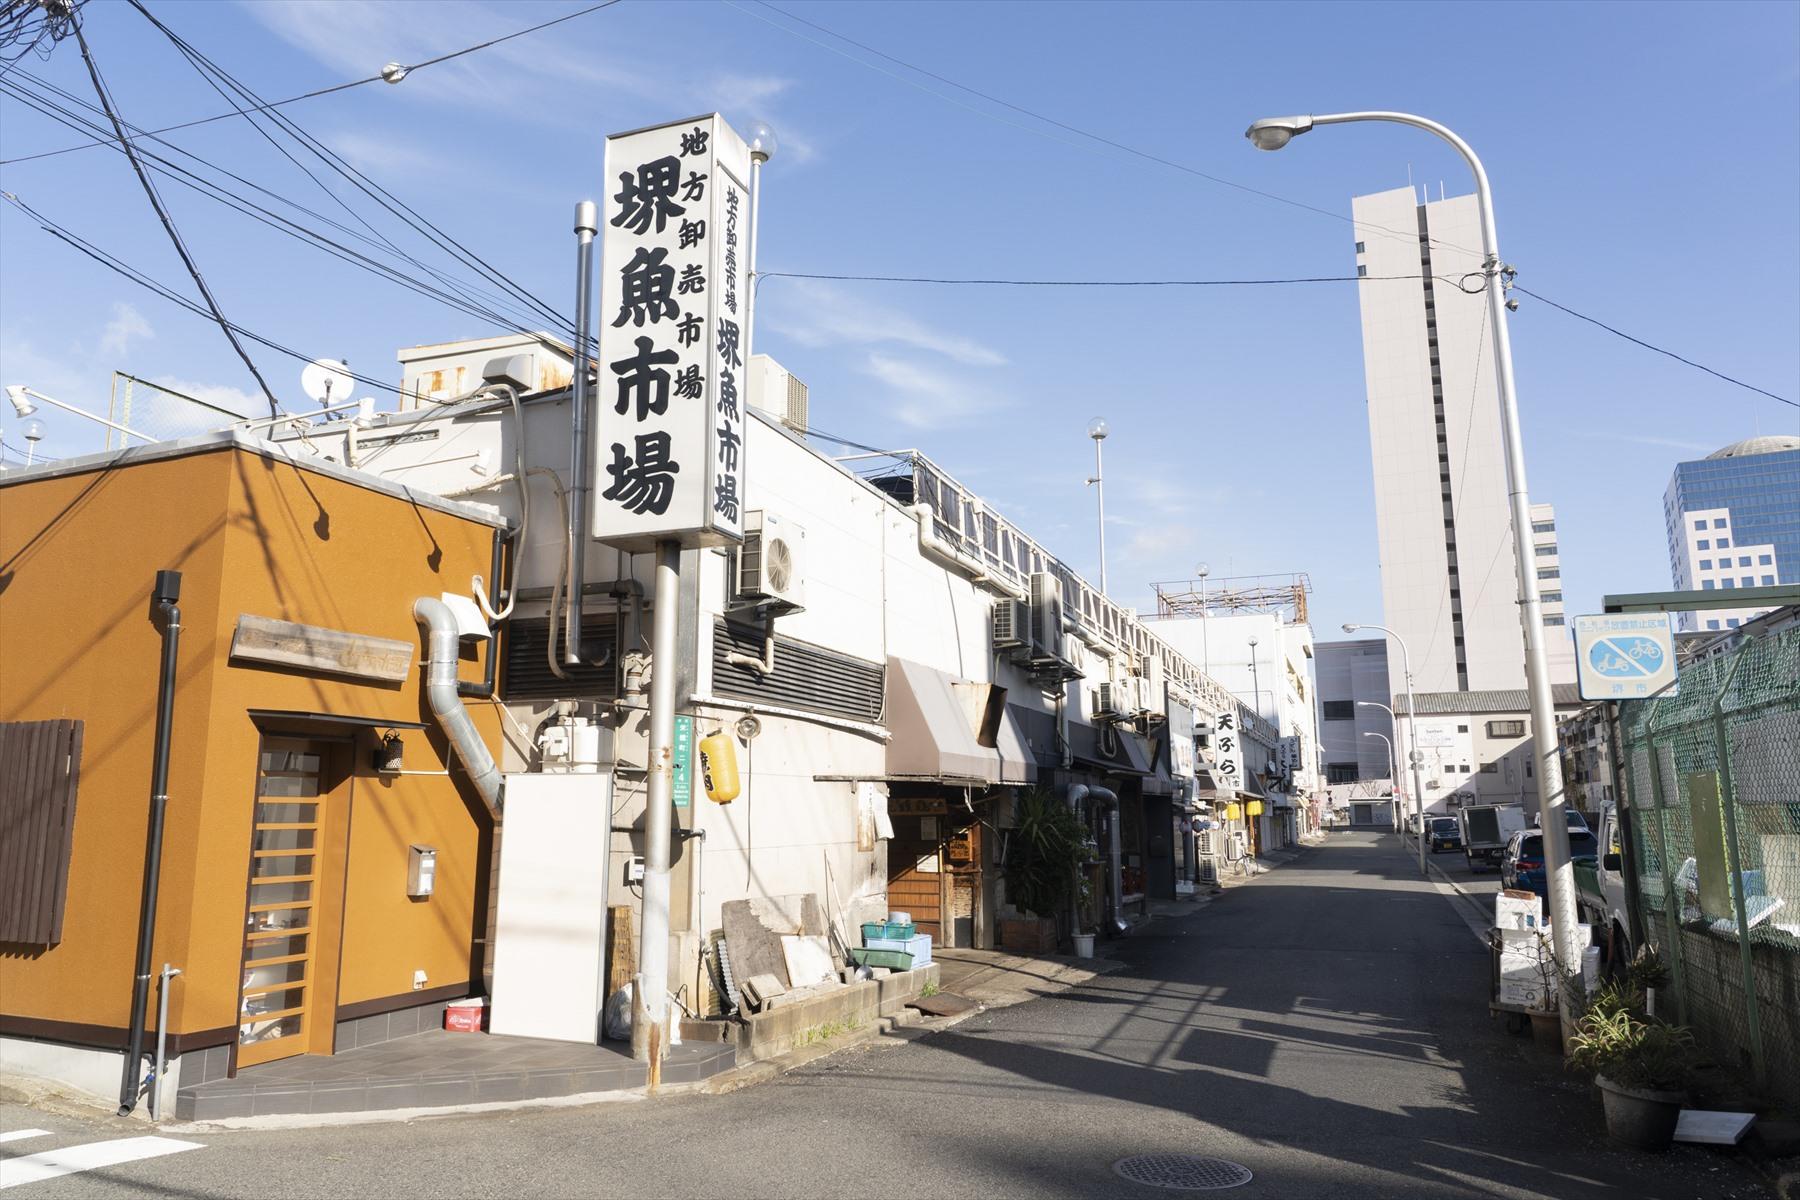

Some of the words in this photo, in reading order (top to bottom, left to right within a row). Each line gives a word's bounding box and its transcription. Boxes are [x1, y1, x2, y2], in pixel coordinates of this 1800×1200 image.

[602, 155, 686, 516] 堺魚市場
[673, 126, 708, 400] 地方卸売市場
[723, 185, 739, 315] 地方卸売市場
[715, 316, 742, 526] 堺魚市場
[1217, 713, 1236, 775] 天ぷら
